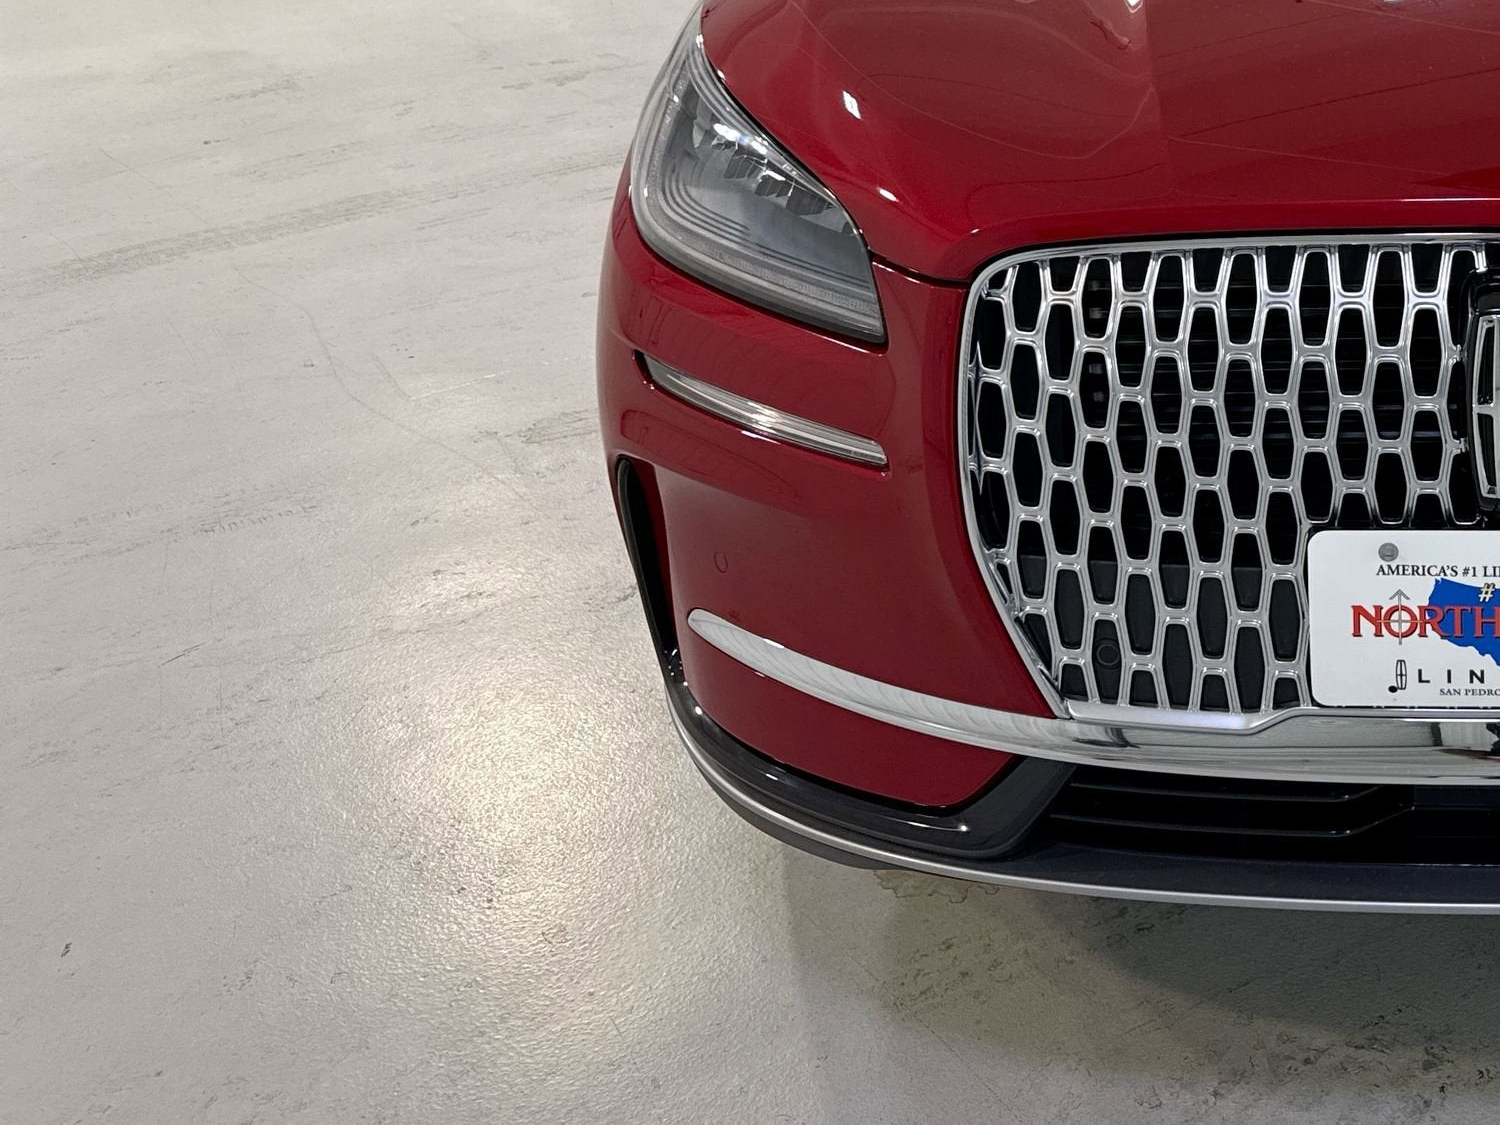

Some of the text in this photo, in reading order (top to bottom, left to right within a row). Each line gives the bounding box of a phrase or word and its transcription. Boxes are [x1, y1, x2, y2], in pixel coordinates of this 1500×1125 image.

[1376, 564, 1459, 577] AMERICA'S
[1461, 566, 1478, 578] #1
[1439, 688, 1462, 697] SAN
